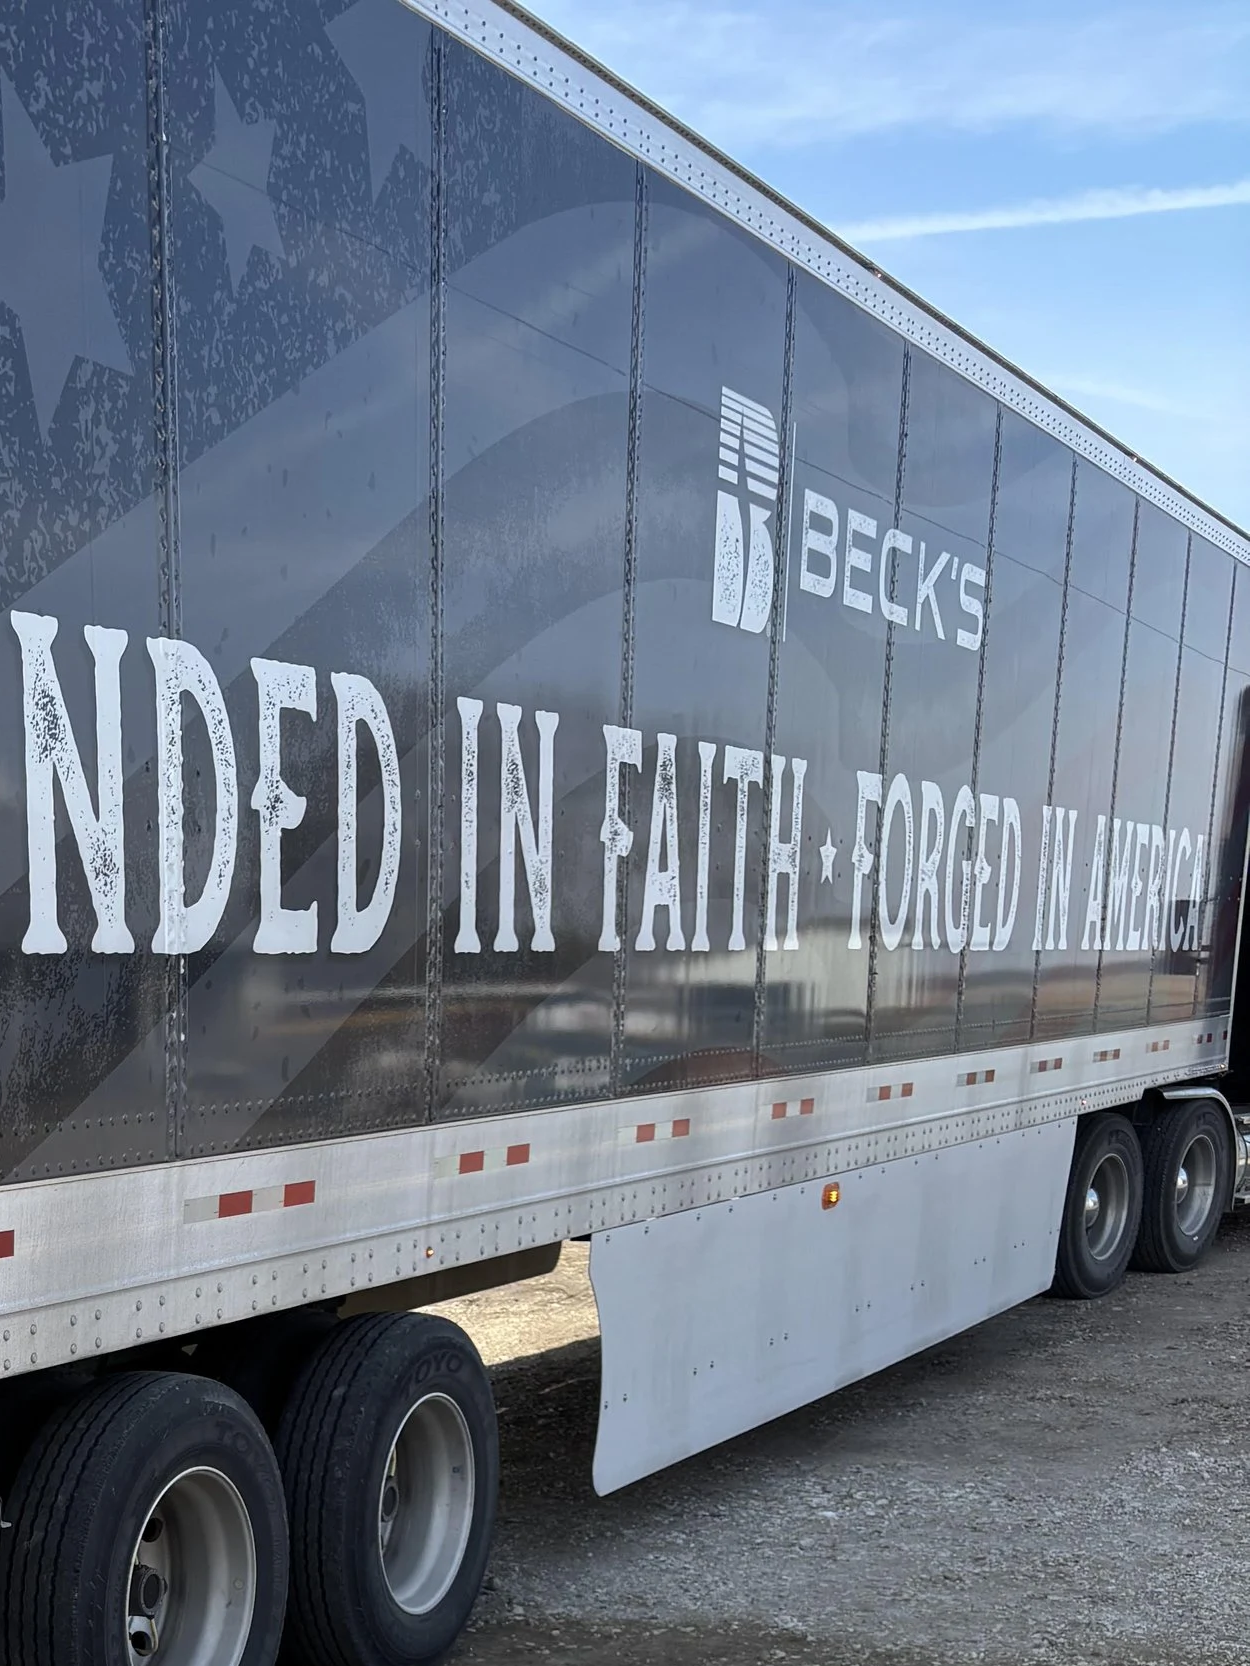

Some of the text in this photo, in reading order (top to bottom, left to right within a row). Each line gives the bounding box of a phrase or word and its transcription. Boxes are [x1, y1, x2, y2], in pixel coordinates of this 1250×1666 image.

[800, 488, 987, 651] BECK'S
[453, 696, 559, 954] IN
[597, 725, 808, 953] FAITH
[848, 771, 1022, 953] FORGED
[1031, 805, 1078, 951] IN
[1081, 815, 1204, 952] AMERICA
